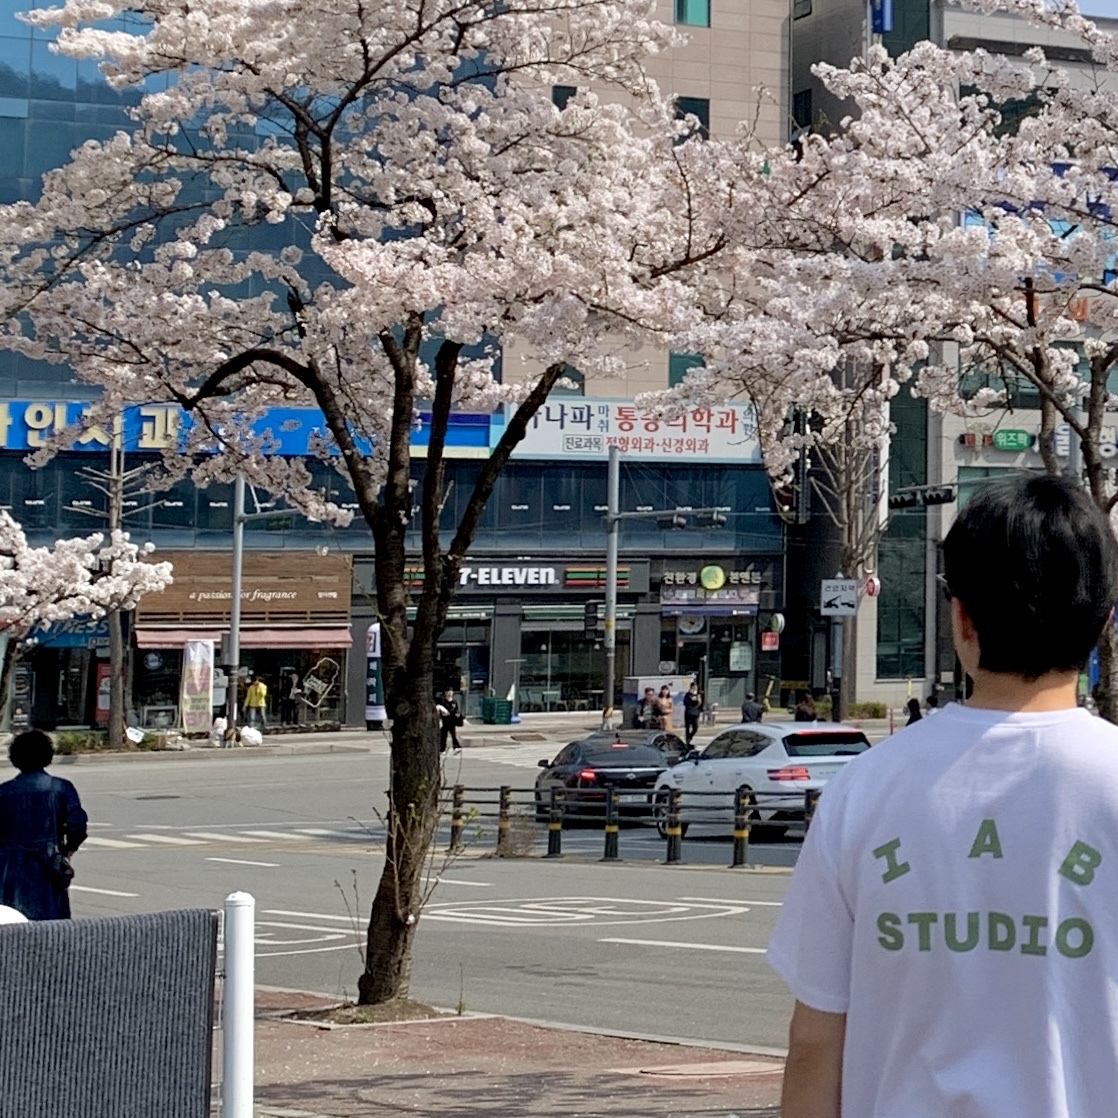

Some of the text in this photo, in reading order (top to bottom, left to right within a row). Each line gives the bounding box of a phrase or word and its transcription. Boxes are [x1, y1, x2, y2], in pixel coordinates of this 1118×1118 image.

[0, 402, 178, 450] 인치과
[597, 405, 611, 433] 마취
[565, 436, 602, 451] 진료과목
[250, 588, 298, 602] fragrance
[876, 910, 1095, 959] STUDIO
